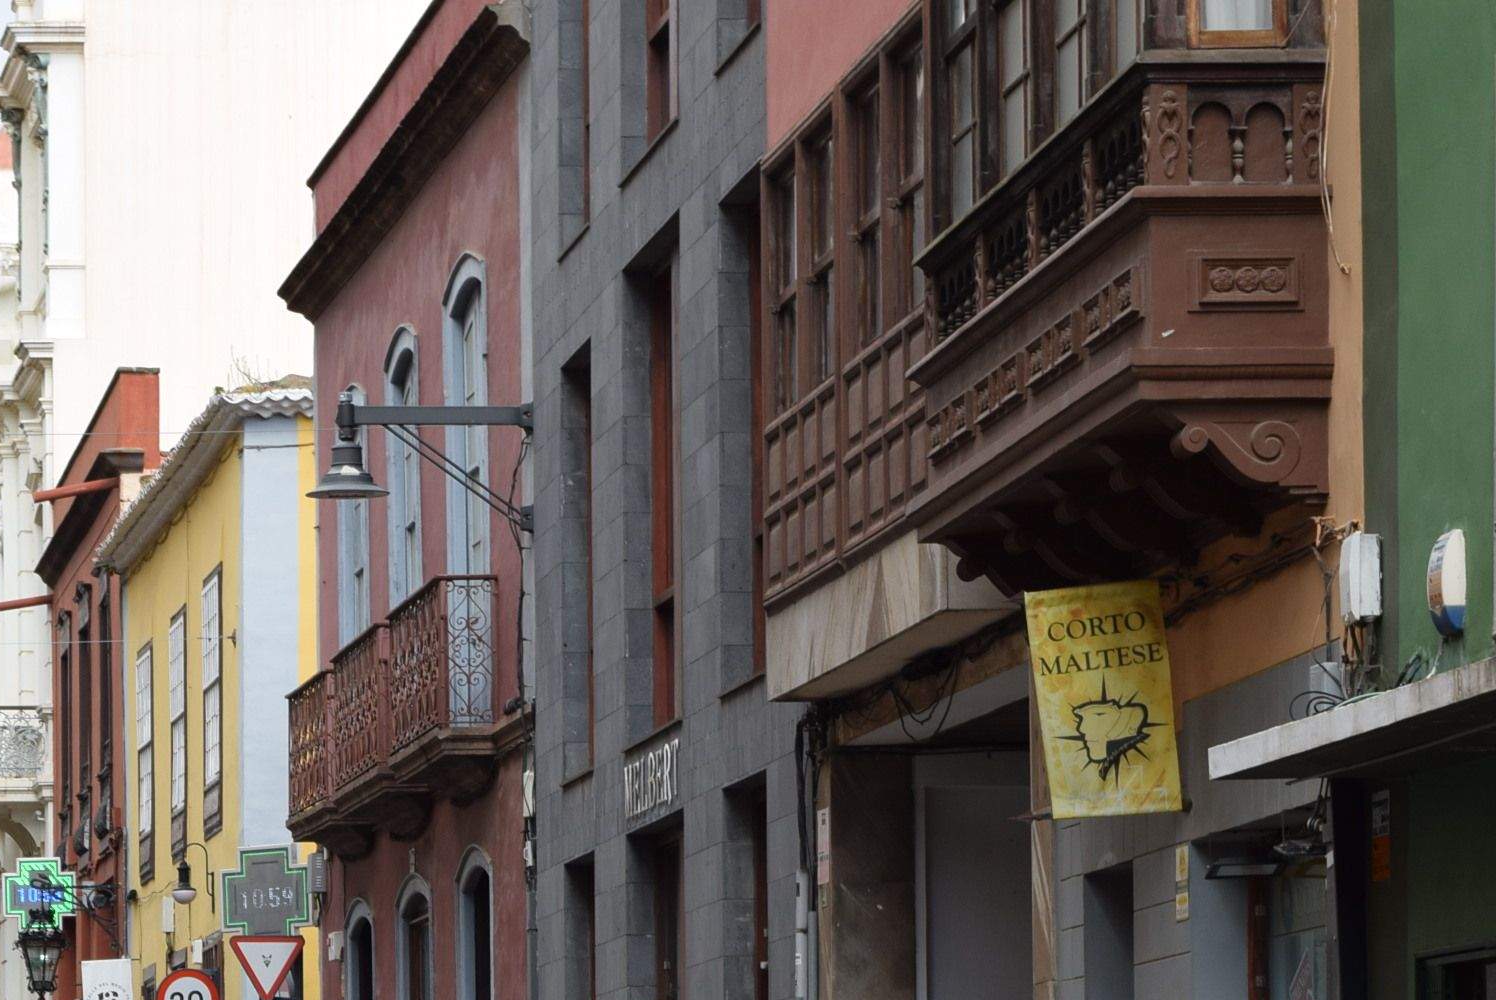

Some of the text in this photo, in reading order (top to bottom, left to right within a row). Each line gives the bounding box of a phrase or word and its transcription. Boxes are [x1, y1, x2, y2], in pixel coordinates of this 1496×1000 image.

[1047, 610, 1146, 642] CORTO
[1039, 641, 1164, 677] MALTESE
[624, 738, 679, 817] MELBERT
